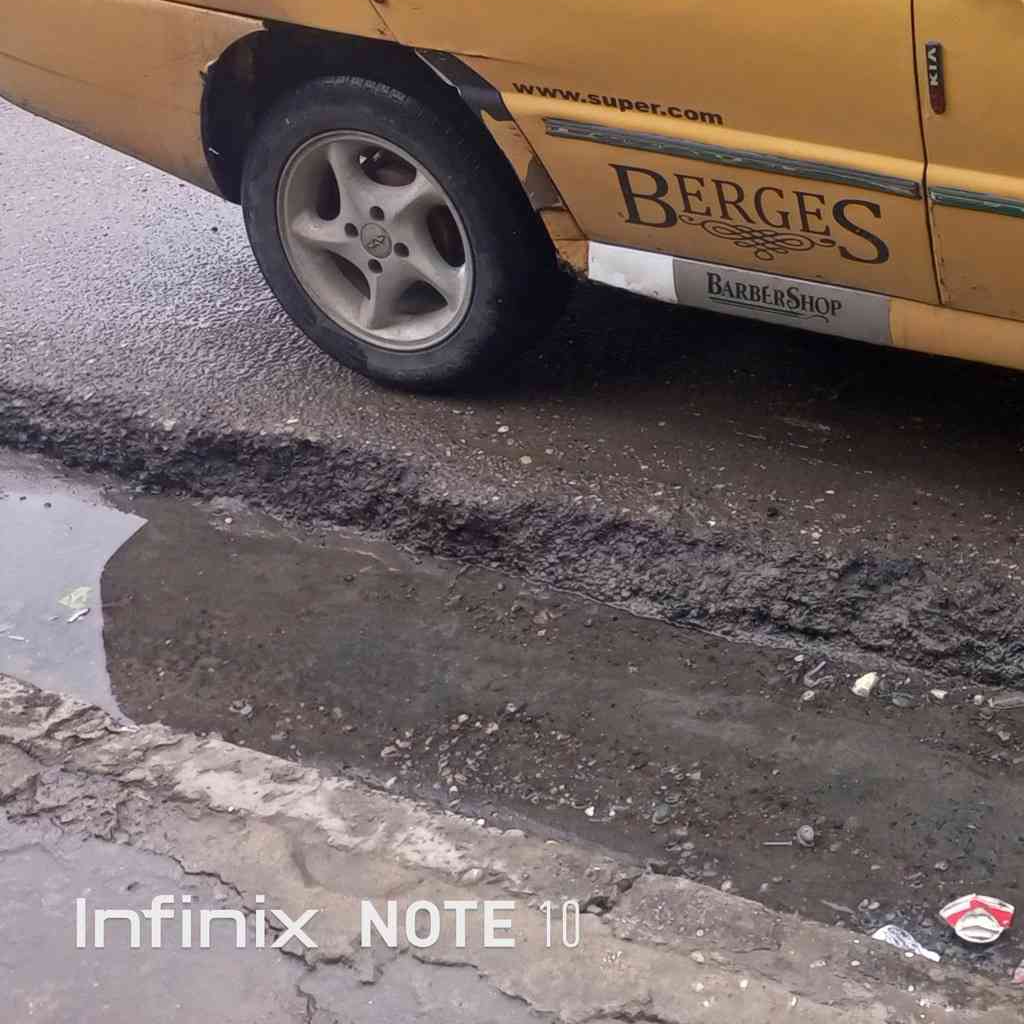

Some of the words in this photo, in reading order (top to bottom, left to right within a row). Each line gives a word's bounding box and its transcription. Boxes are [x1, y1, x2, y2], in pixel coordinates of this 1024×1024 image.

[512, 81, 724, 126] www.super.com
[608, 163, 890, 265] BERGES
[706, 272, 842, 317] BARBERSHOP
